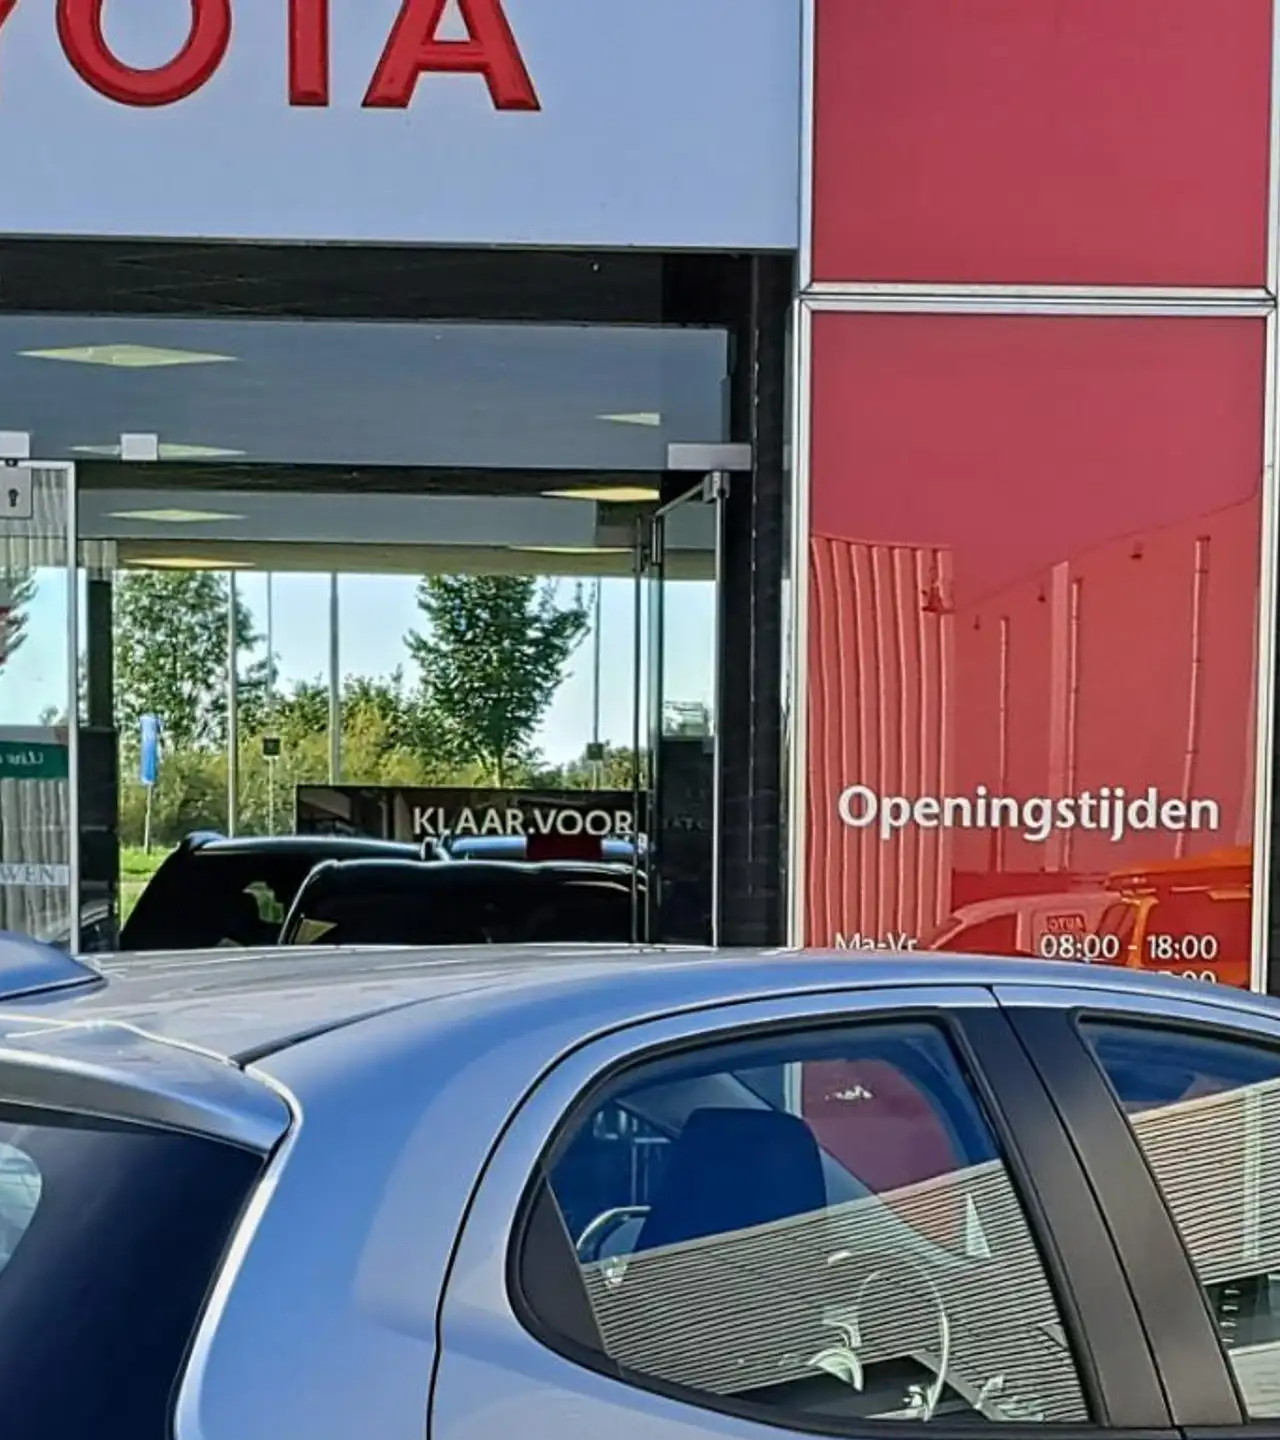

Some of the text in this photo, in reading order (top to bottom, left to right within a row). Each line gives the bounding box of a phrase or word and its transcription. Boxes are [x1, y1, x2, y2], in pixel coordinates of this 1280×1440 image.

[837, 784, 1220, 842] Openingstijden
[1039, 932, 1120, 960] 08:00
[1147, 933, 1218, 961] 18:00
